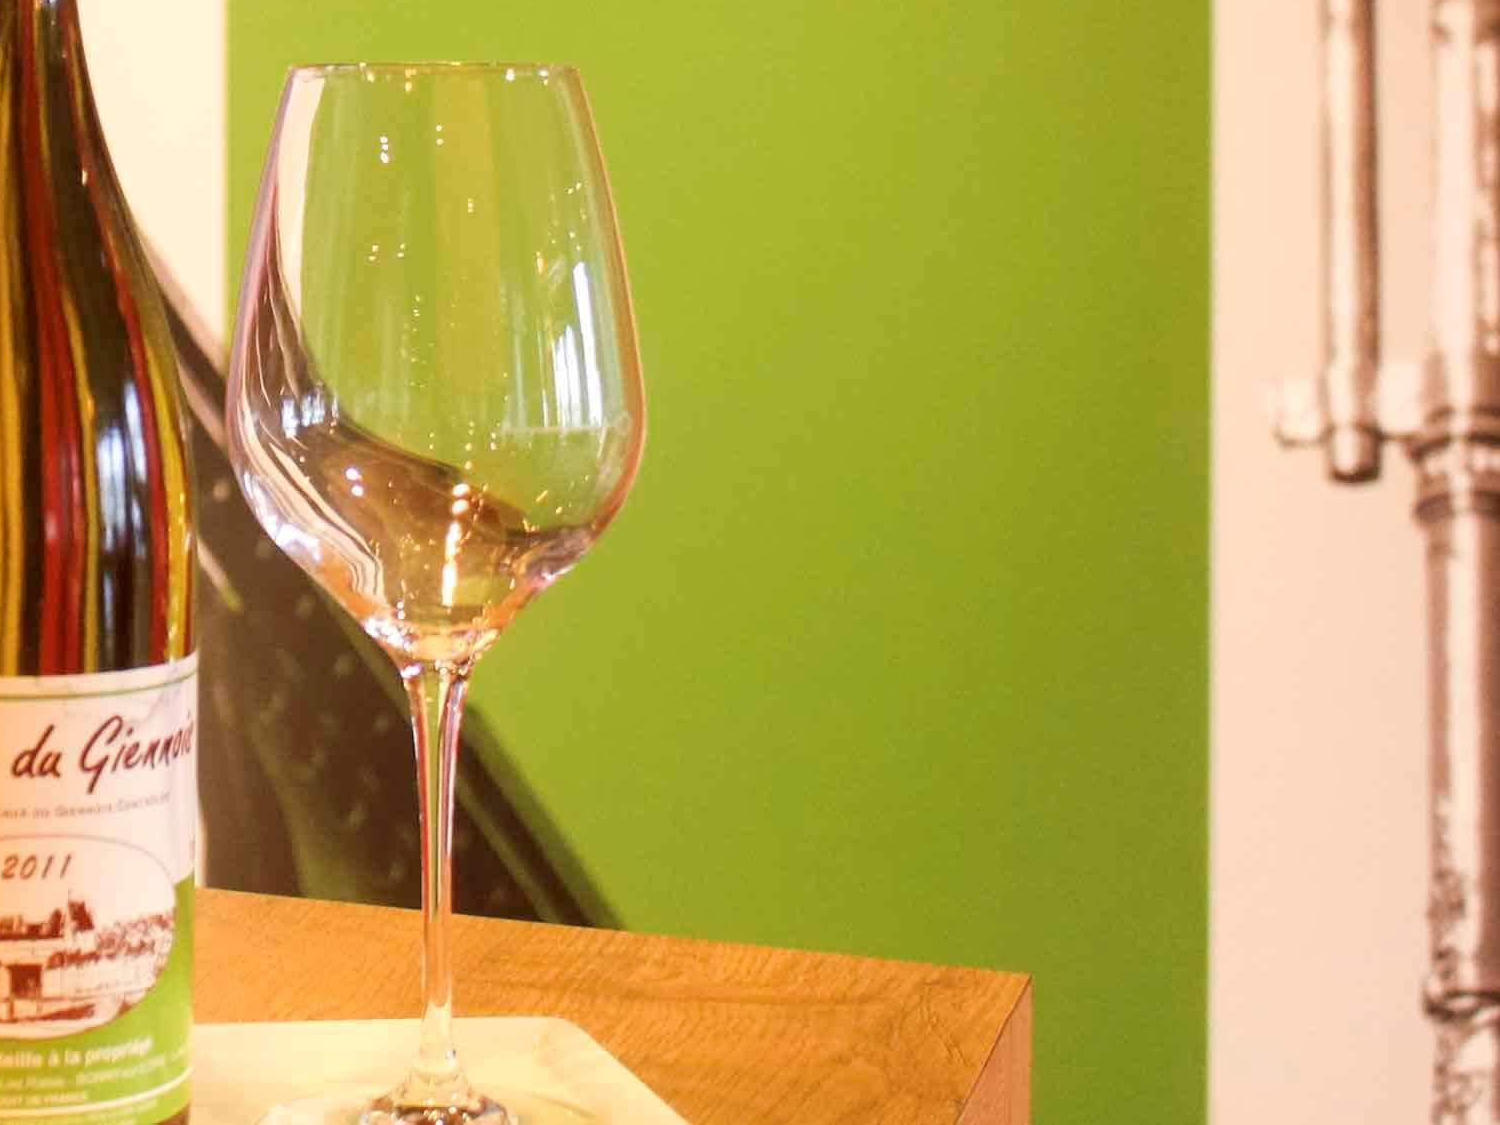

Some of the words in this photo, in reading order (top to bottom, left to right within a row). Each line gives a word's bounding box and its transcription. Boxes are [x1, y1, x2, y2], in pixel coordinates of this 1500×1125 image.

[11, 724, 62, 778] du
[0, 852, 73, 881] 2011
[48, 1047, 59, 1067] à
[63, 1046, 82, 1066] la
